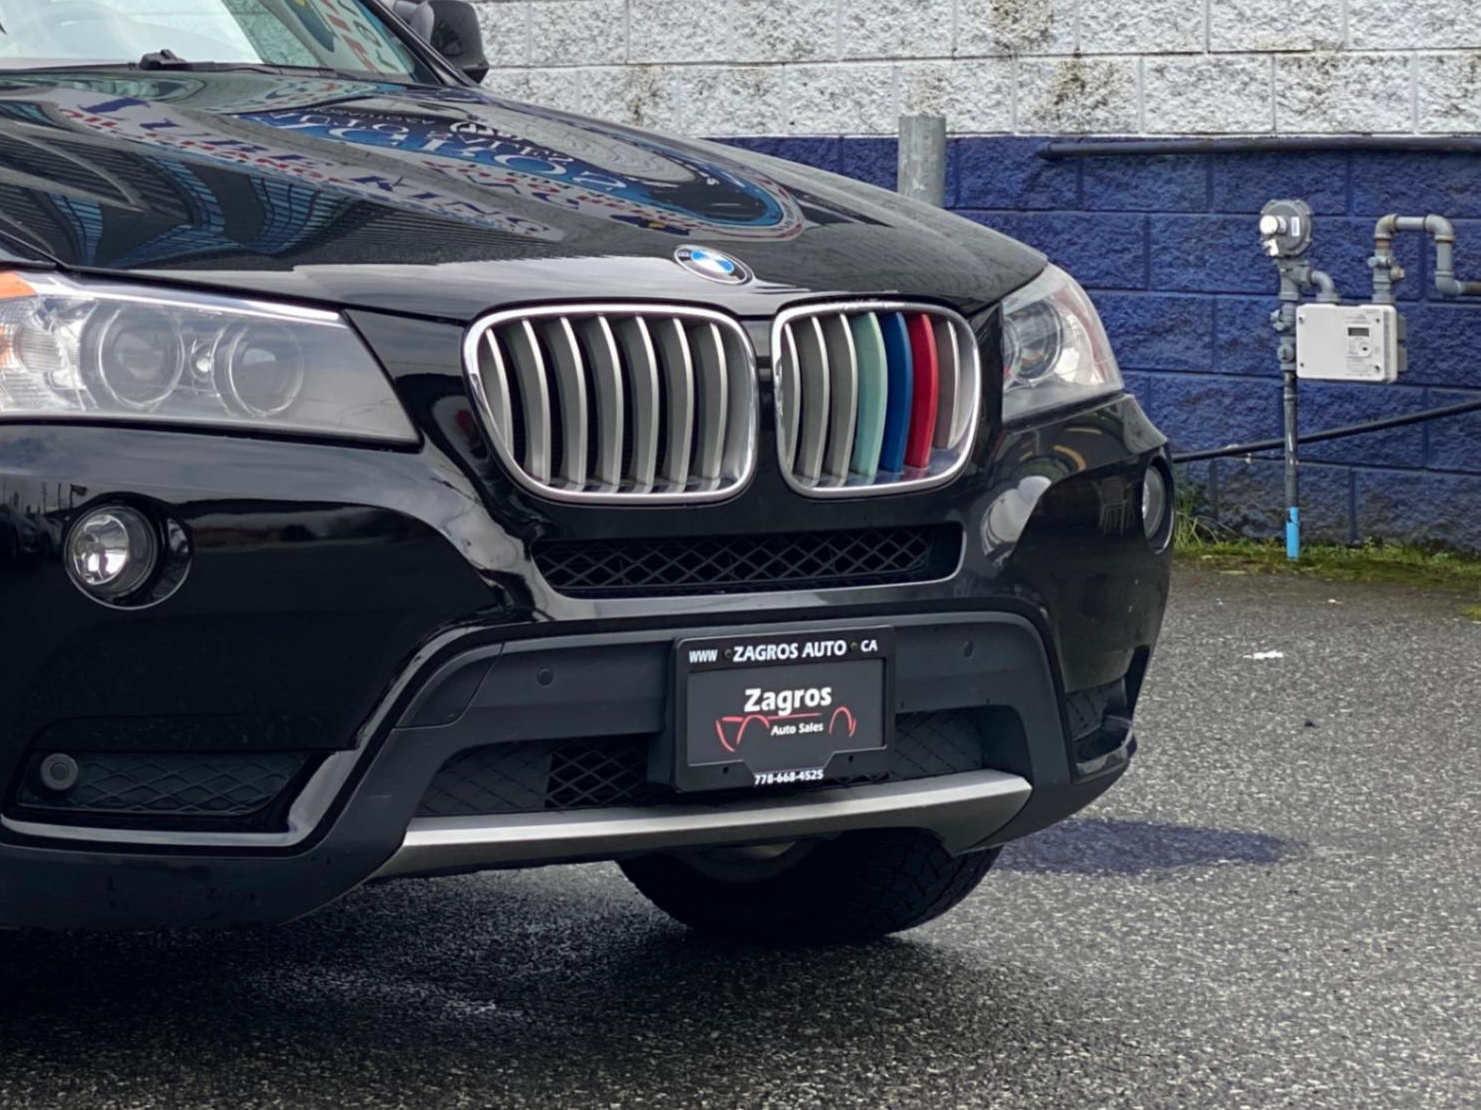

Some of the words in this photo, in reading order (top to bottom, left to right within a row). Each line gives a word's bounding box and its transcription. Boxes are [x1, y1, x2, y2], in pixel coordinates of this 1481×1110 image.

[688, 649, 718, 663] WWW
[732, 643, 799, 663] ZAGROS
[801, 640, 847, 658] AUTO
[860, 640, 878, 652] CA
[744, 687, 832, 716] Zagros
[770, 724, 797, 736] Auto
[798, 721, 824, 733] Sales
[754, 769, 824, 785] 778-668-4525
